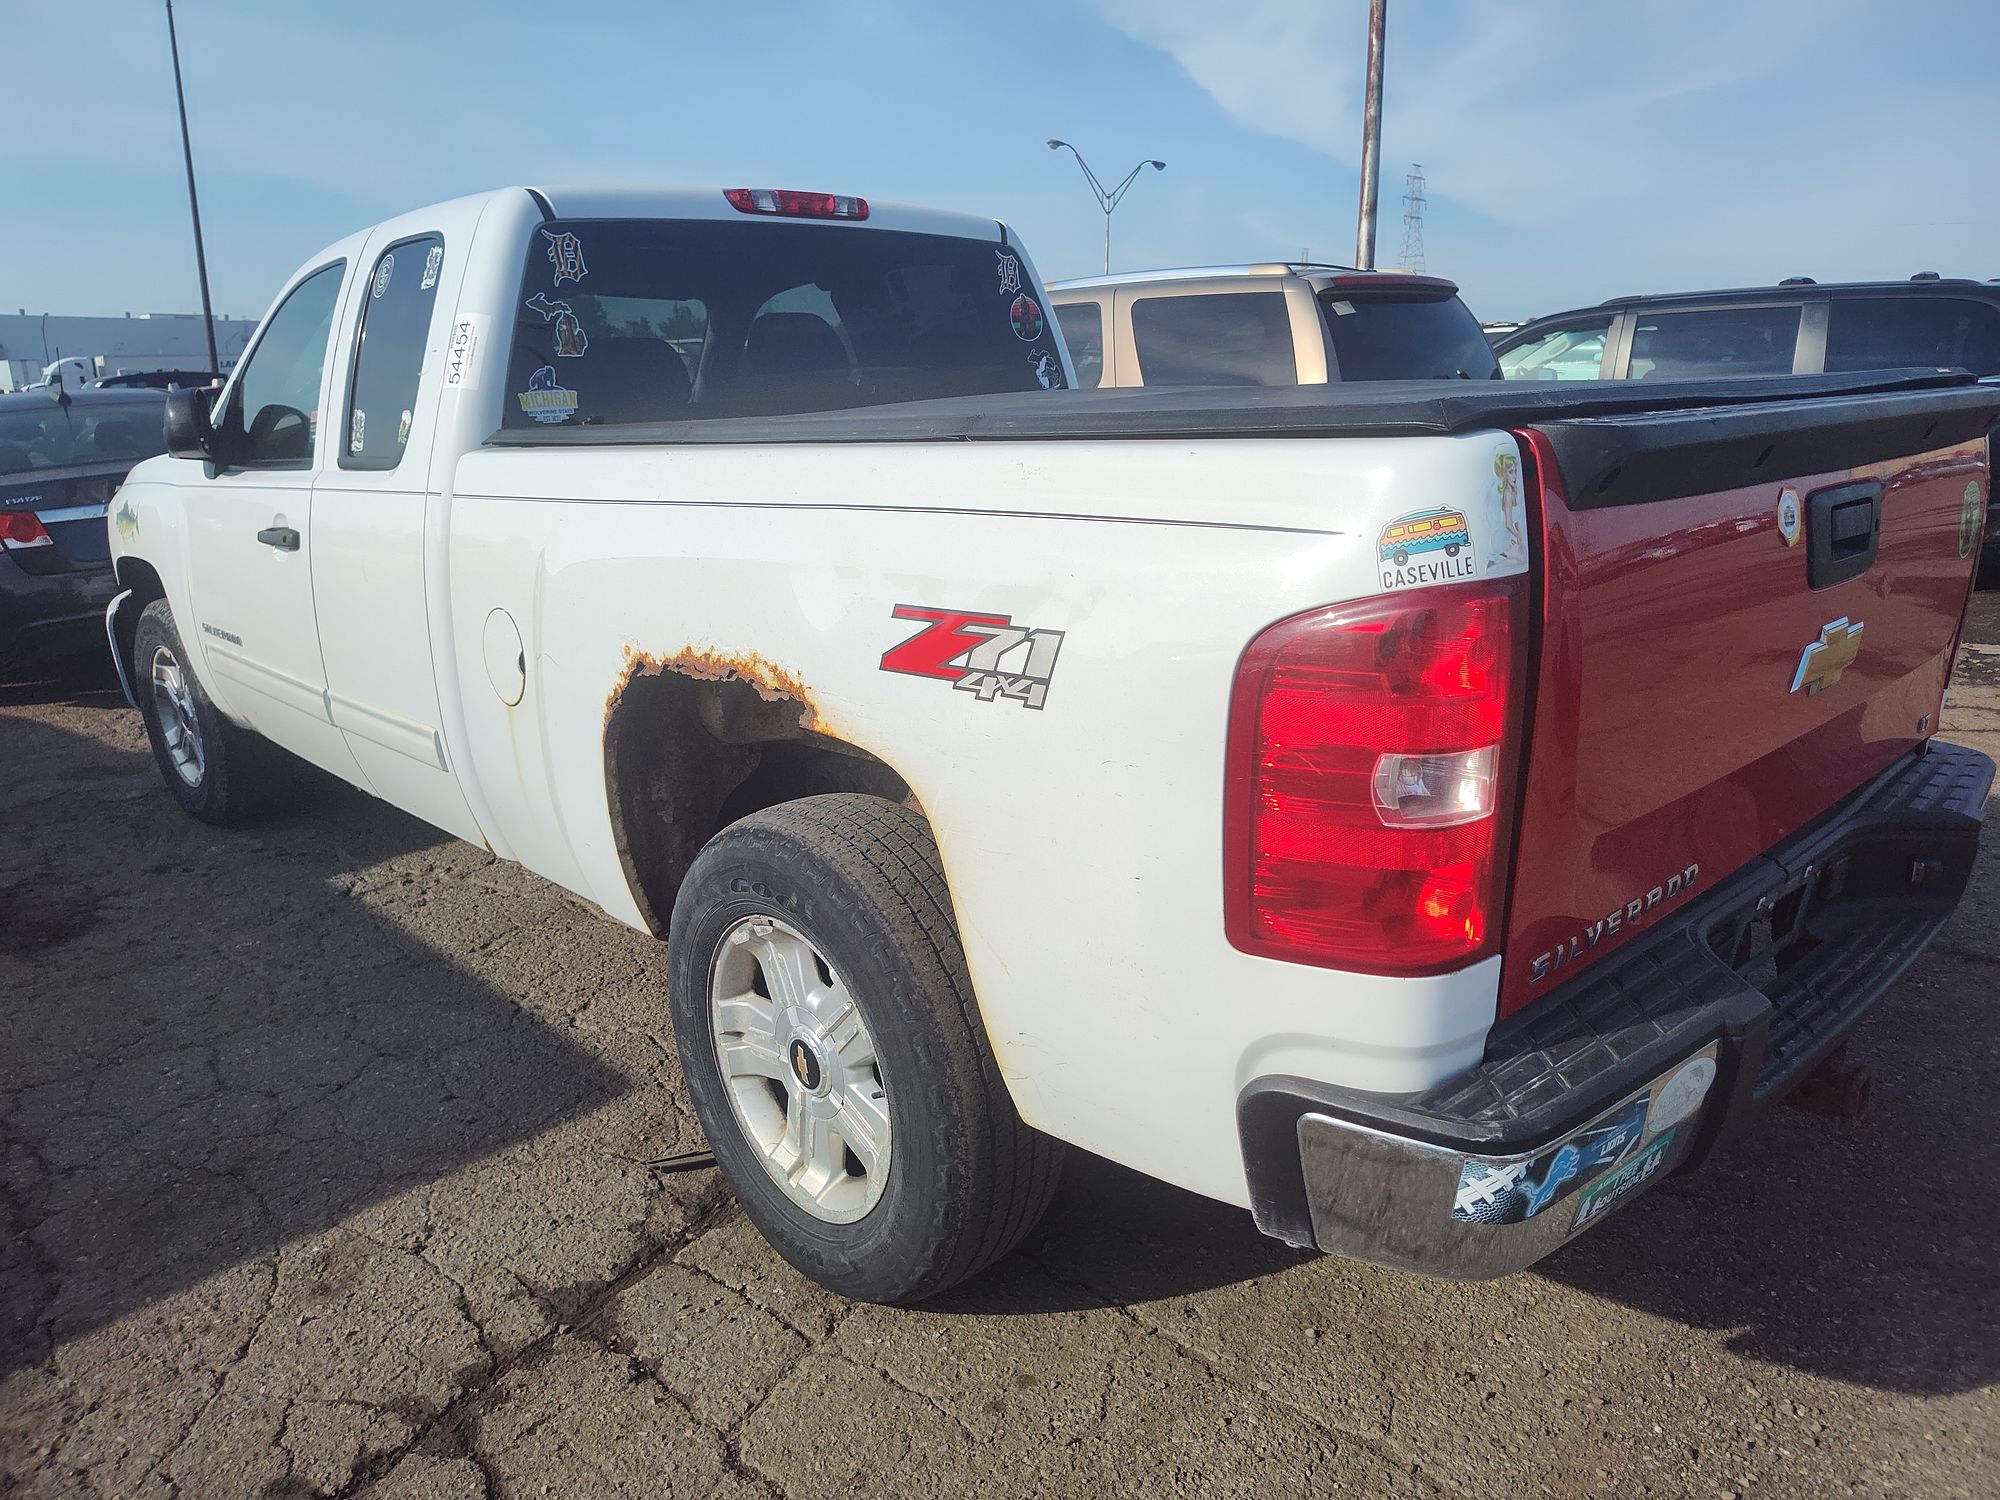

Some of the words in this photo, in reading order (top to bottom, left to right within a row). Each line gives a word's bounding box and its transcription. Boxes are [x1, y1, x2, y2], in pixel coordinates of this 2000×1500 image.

[448, 321, 470, 384] 54454
[521, 392, 577, 409] MICHIGAN
[1383, 556, 1474, 589] CASEVILLE
[879, 603, 1066, 682] Z71
[1528, 863, 1699, 984] SILVERADO
[1600, 1131, 1627, 1156] LIONS
[1599, 1171, 1643, 1208] OUTSIDE
